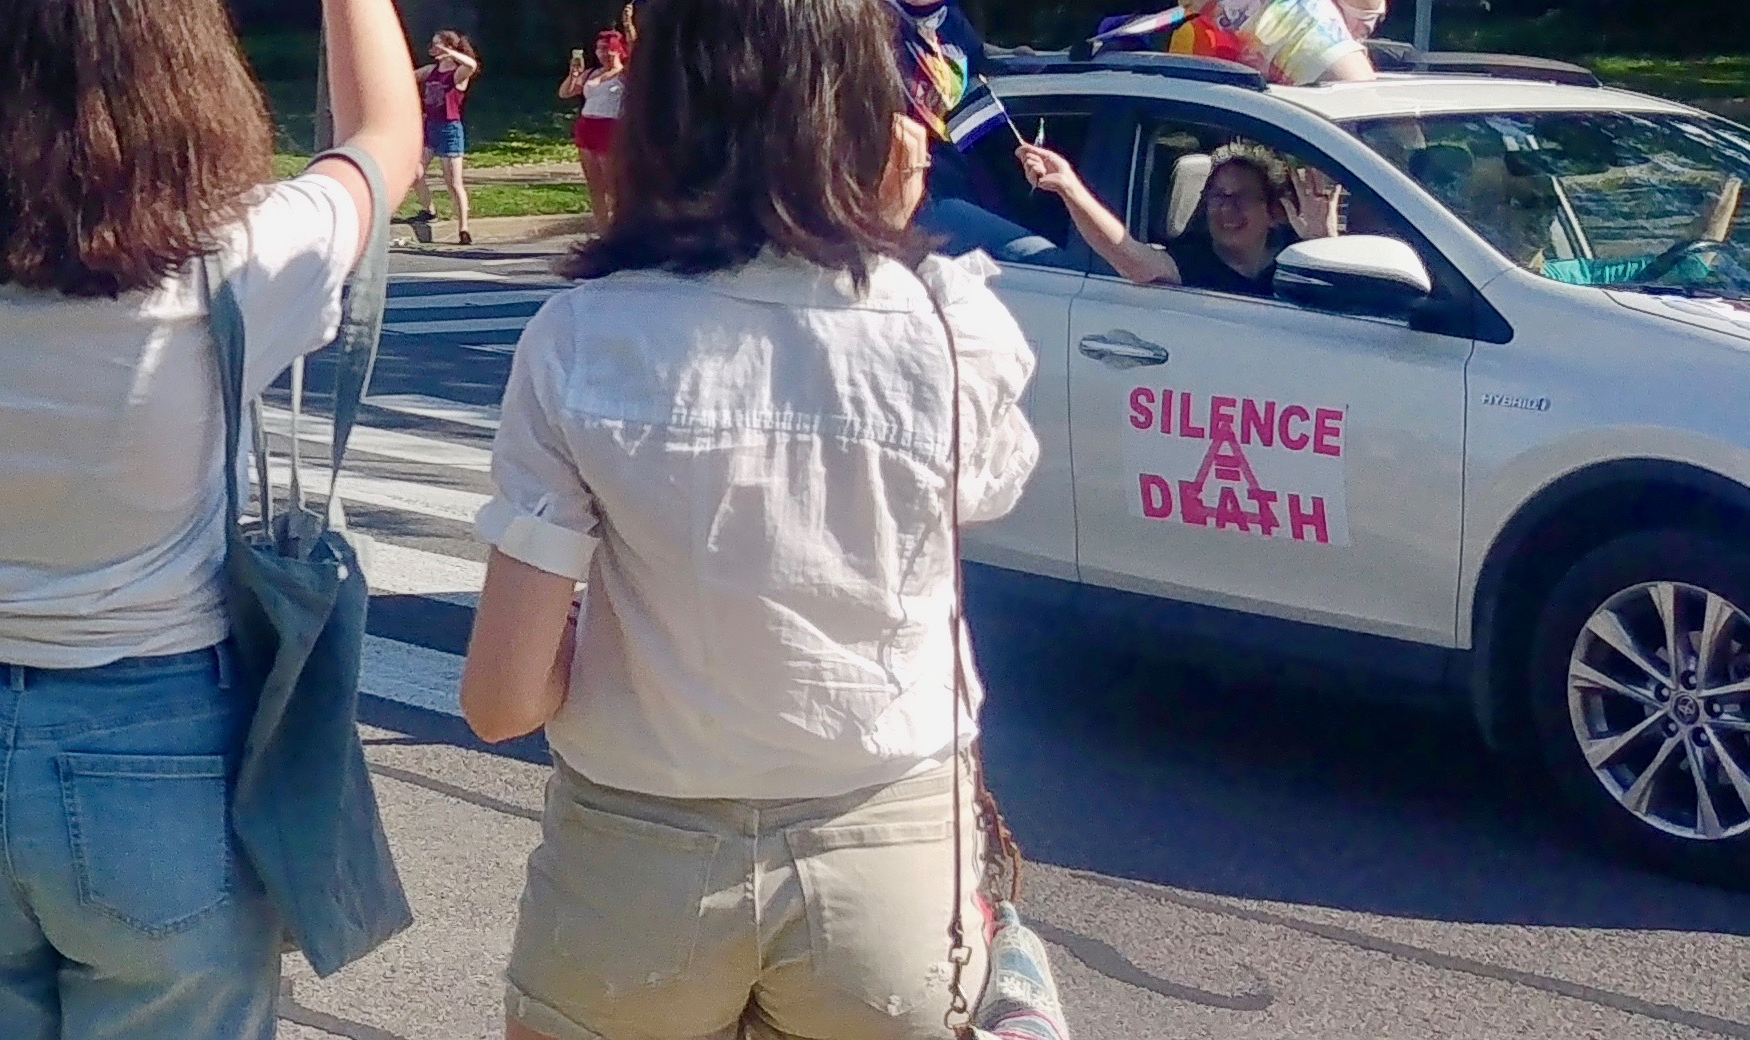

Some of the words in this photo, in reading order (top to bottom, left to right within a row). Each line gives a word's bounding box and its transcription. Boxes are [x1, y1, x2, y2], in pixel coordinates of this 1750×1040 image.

[1129, 387, 1344, 457] SILENCE
[1481, 393, 1537, 411] HYBRID
[1139, 473, 1329, 543] DEATH
